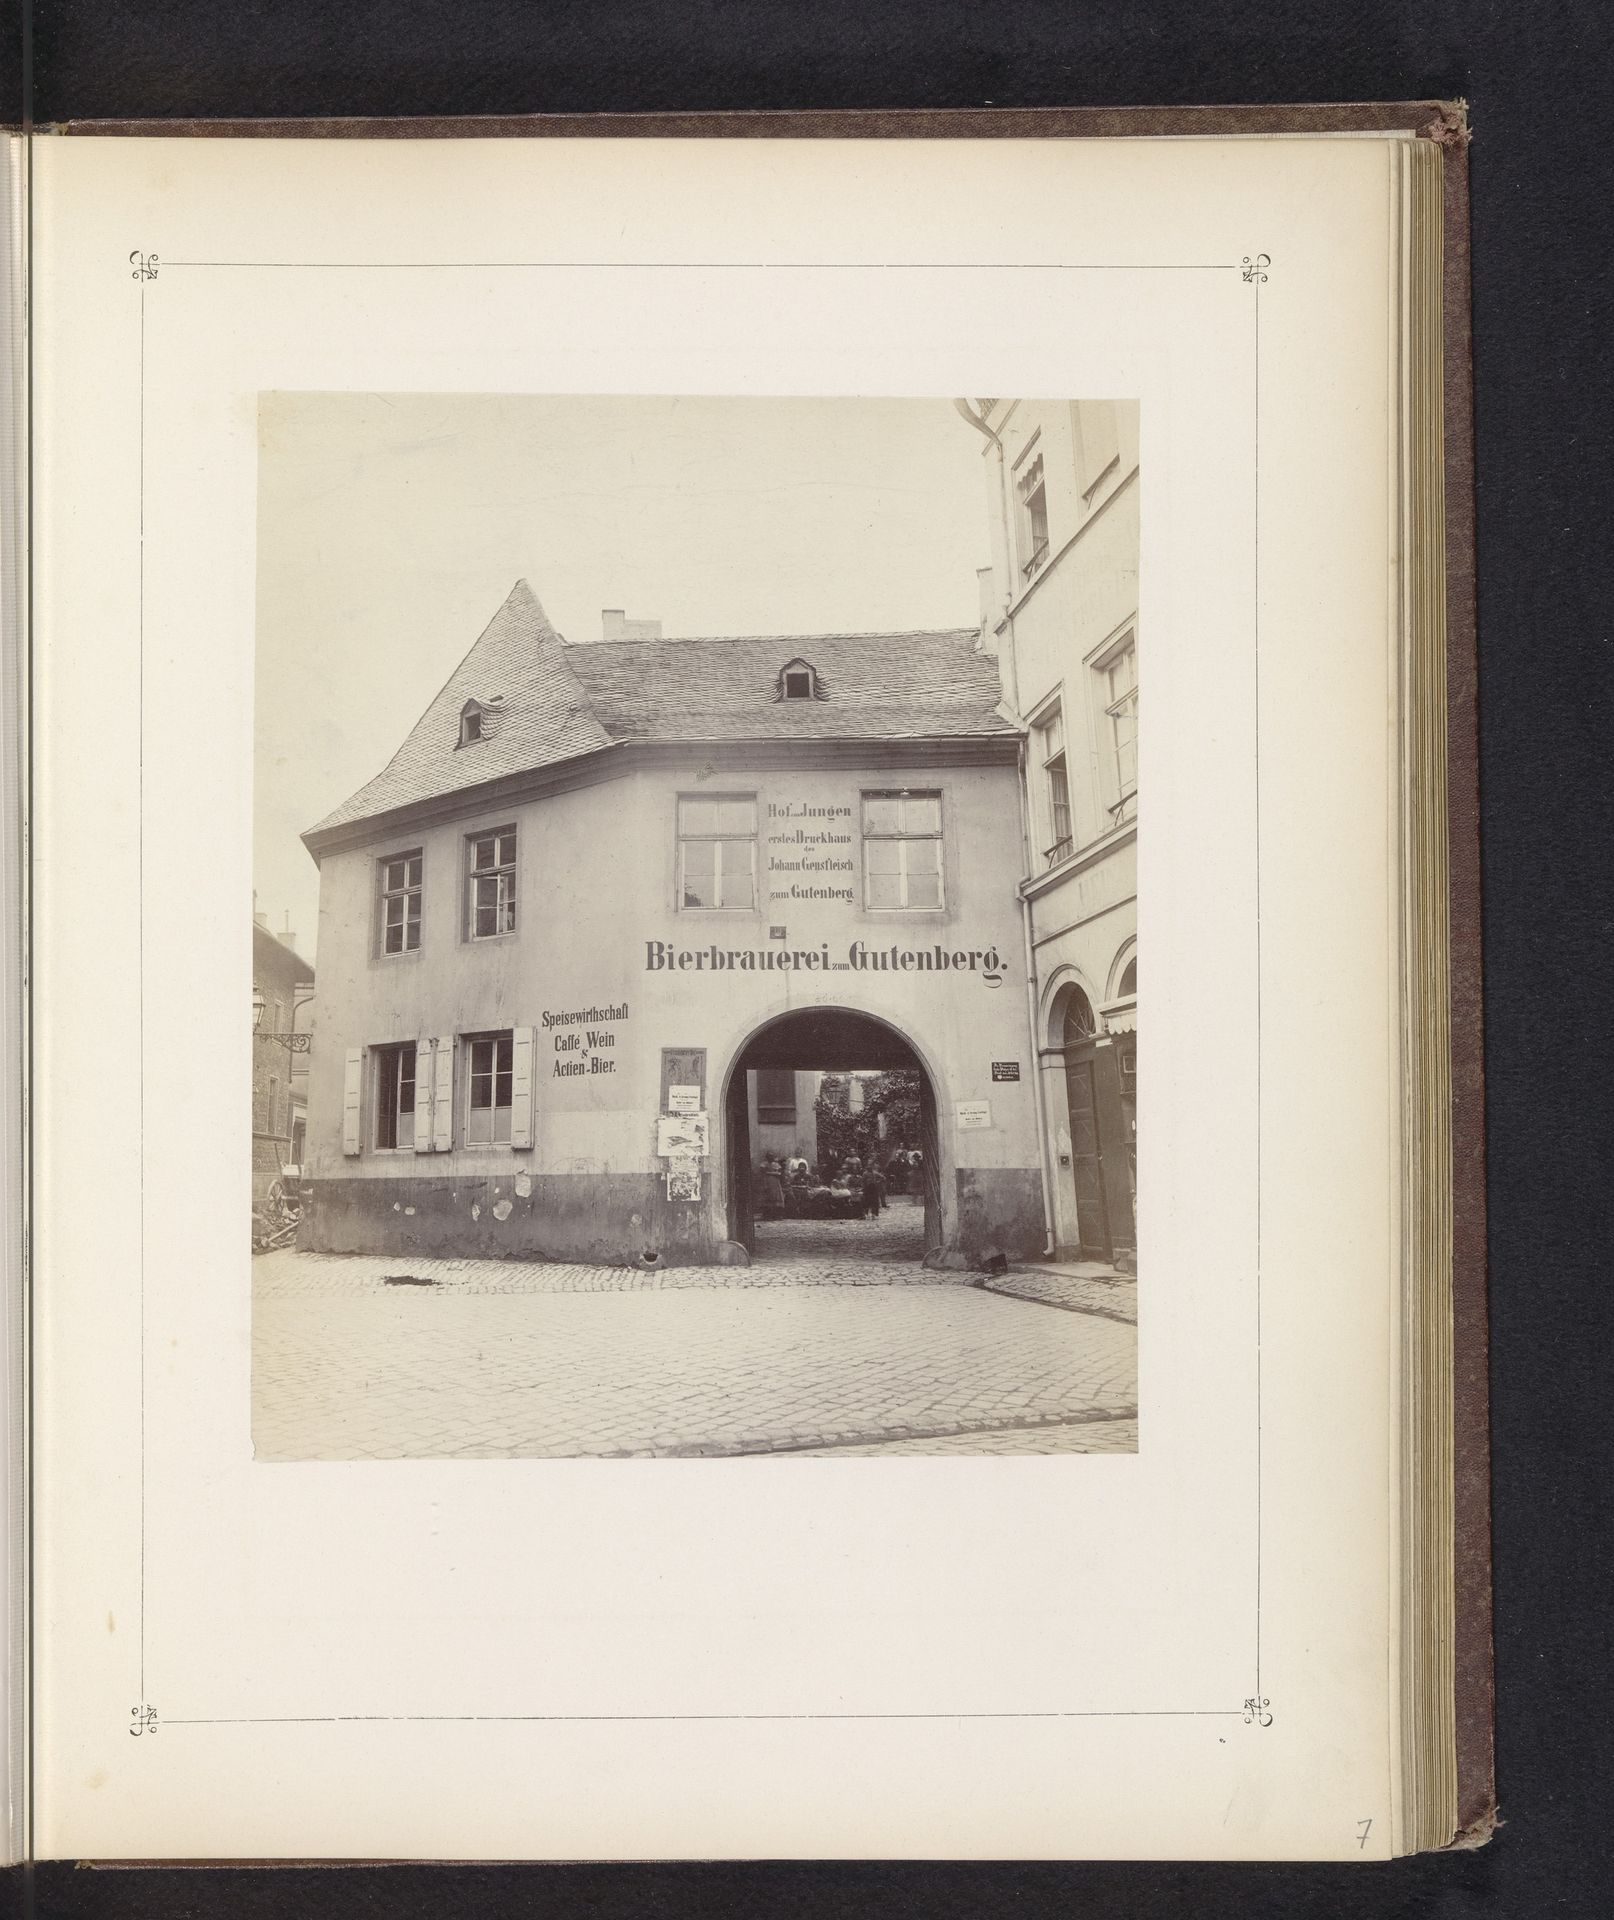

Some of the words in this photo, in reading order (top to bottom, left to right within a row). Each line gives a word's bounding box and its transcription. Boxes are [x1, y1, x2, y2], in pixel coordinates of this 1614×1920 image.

[768, 803, 792, 817] Hof
[800, 802, 851, 823] Jungen
[768, 833, 796, 844] erstes
[796, 830, 852, 844] Druckhaus
[768, 857, 800, 870] Johann
[645, 941, 830, 971] Bierbrauerei
[831, 962, 850, 971] zum
[849, 940, 1008, 989] Gutenberg.
[542, 1003, 629, 1032] Speisewirthschaft
[554, 1034, 581, 1052] Caffé
[586, 1031, 615, 1048] Wein
[581, 1048, 589, 1059] &
[1356, 1818, 1373, 1850] 7
